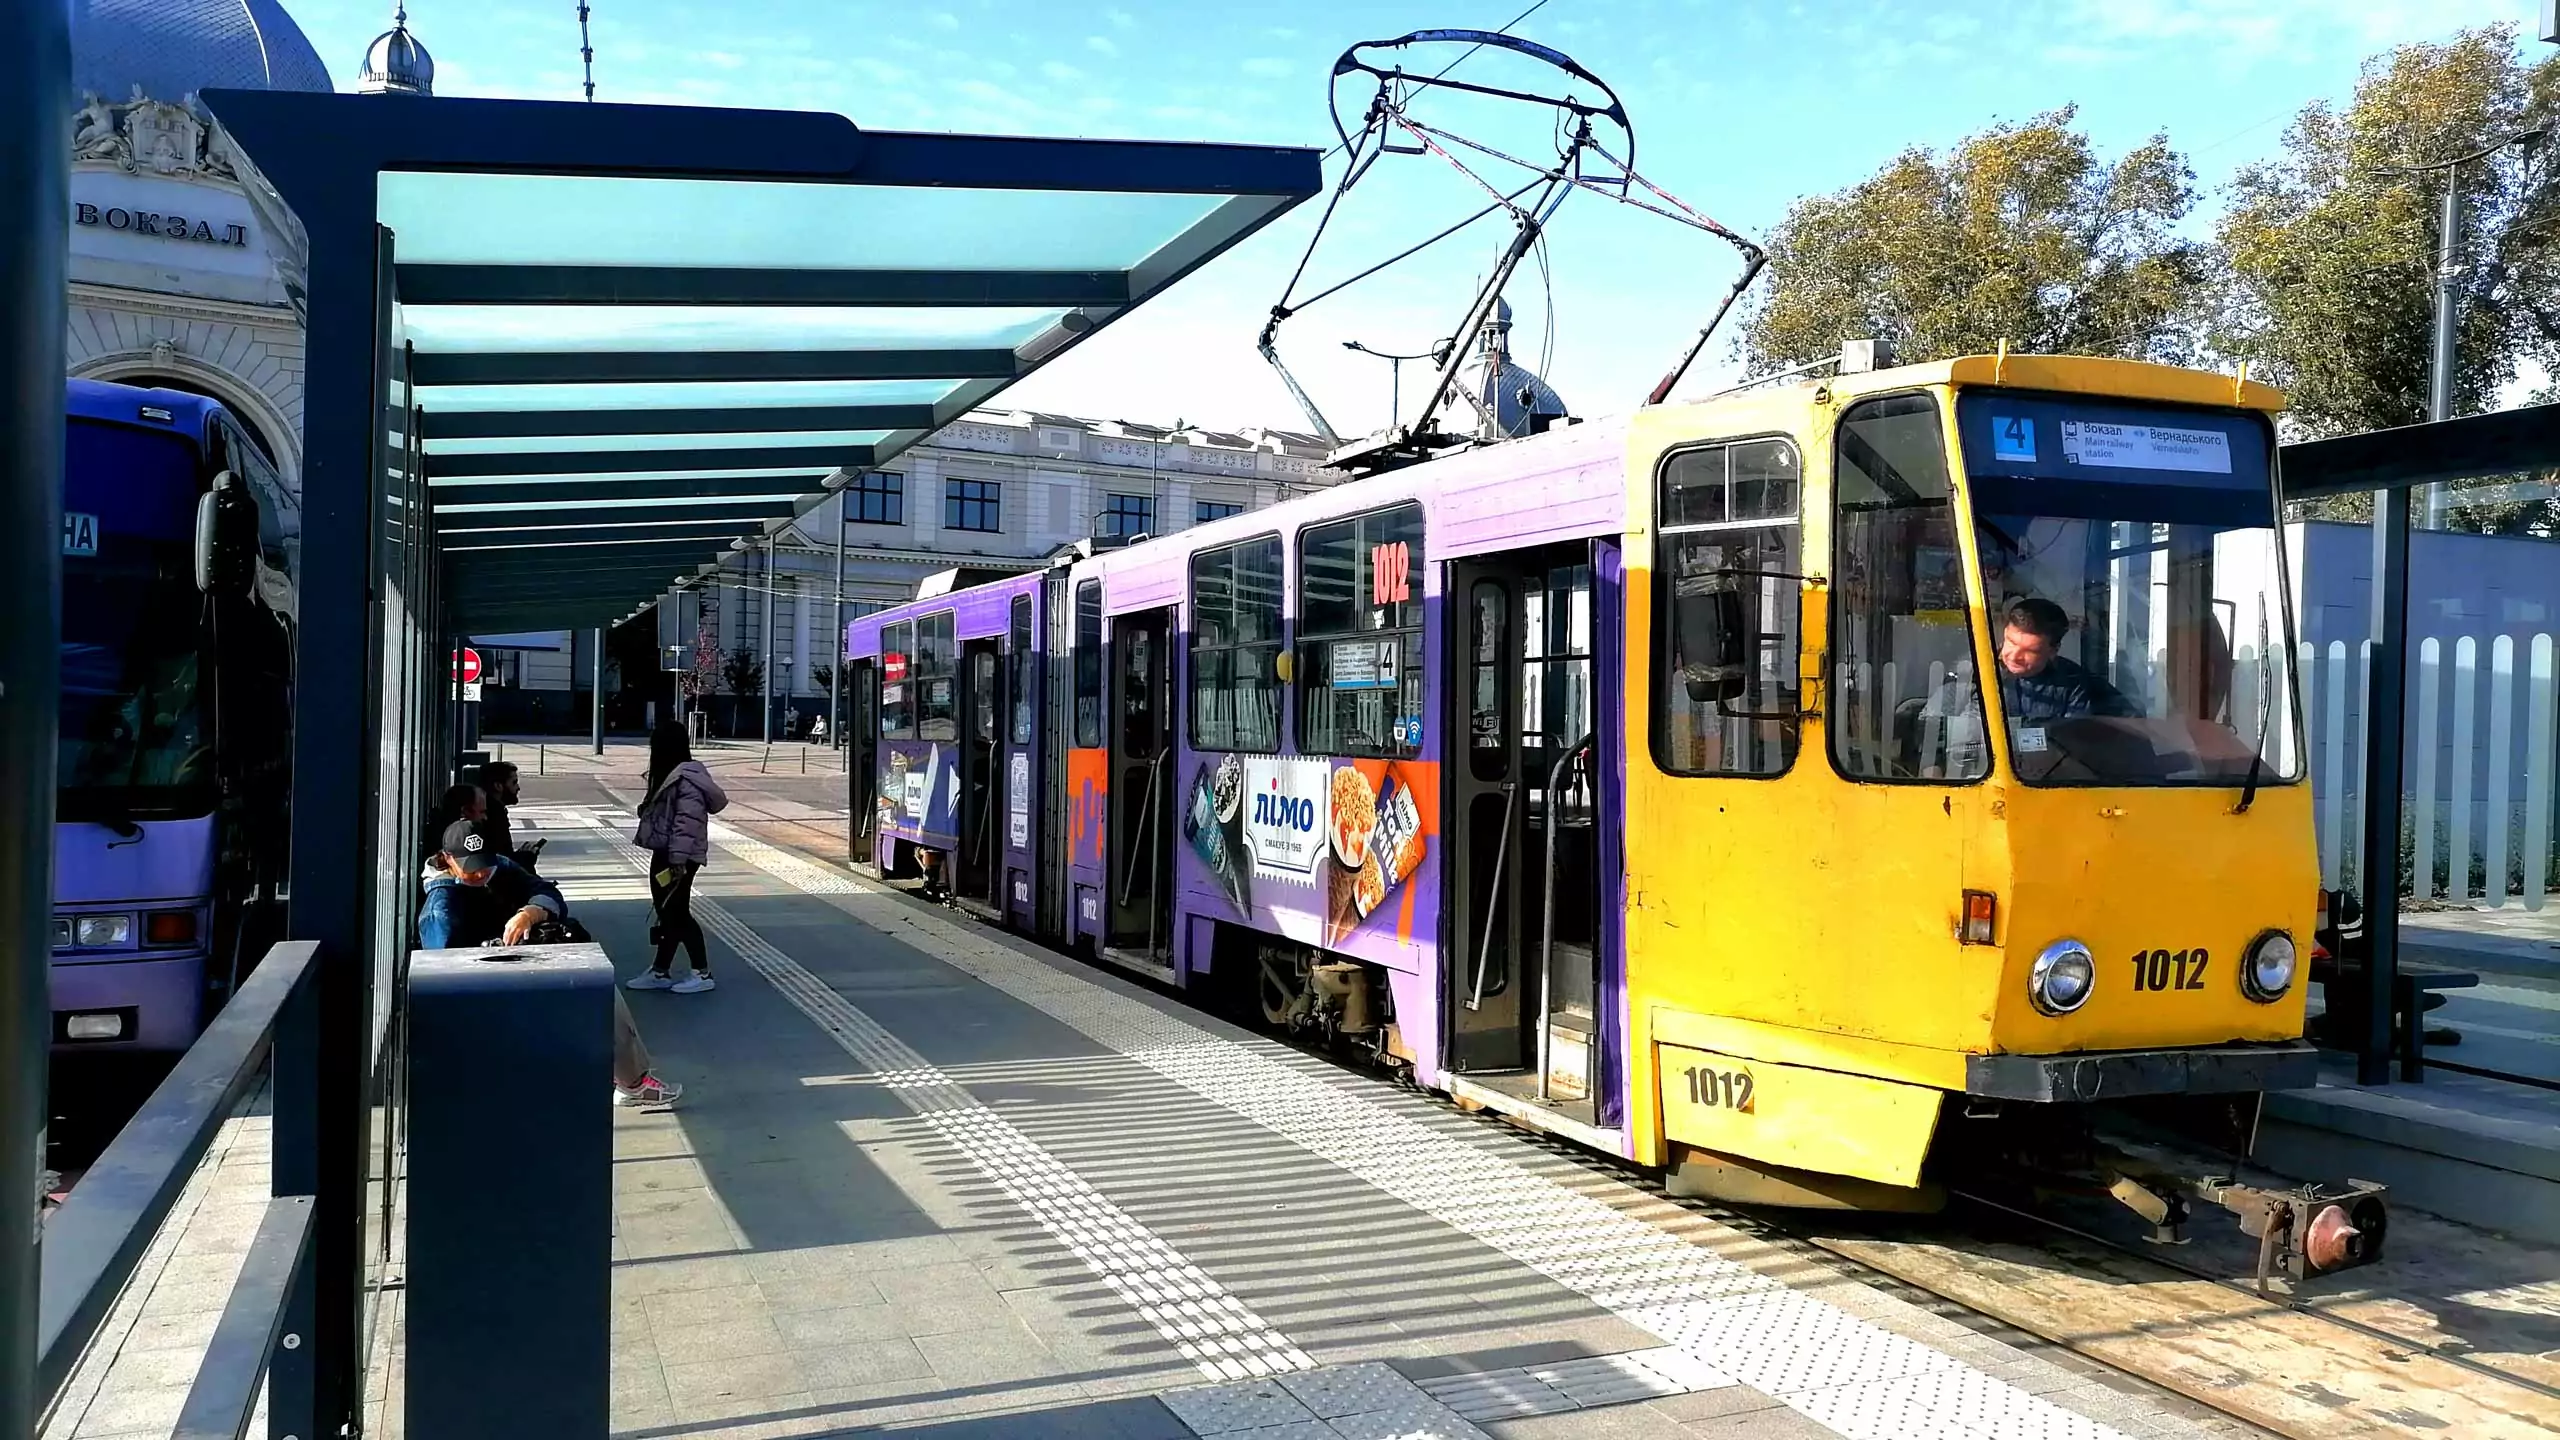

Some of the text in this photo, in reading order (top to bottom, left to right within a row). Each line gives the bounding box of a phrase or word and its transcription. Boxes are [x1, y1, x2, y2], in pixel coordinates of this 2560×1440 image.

[75, 202, 247, 248] ВОКЗАЛ
[2004, 416, 2026, 449] 4
[2084, 421, 2222, 446] Вокзал Вернадського
[2085, 437, 2134, 450] Main railway
[2085, 449, 2115, 459] station
[1371, 541, 1409, 605] 1012
[1382, 643, 1393, 677] 4
[1015, 881, 1028, 902] 1012
[1081, 897, 1097, 921] 1012
[2131, 948, 2209, 992] 1012
[1684, 1066, 1753, 1110] 1012
